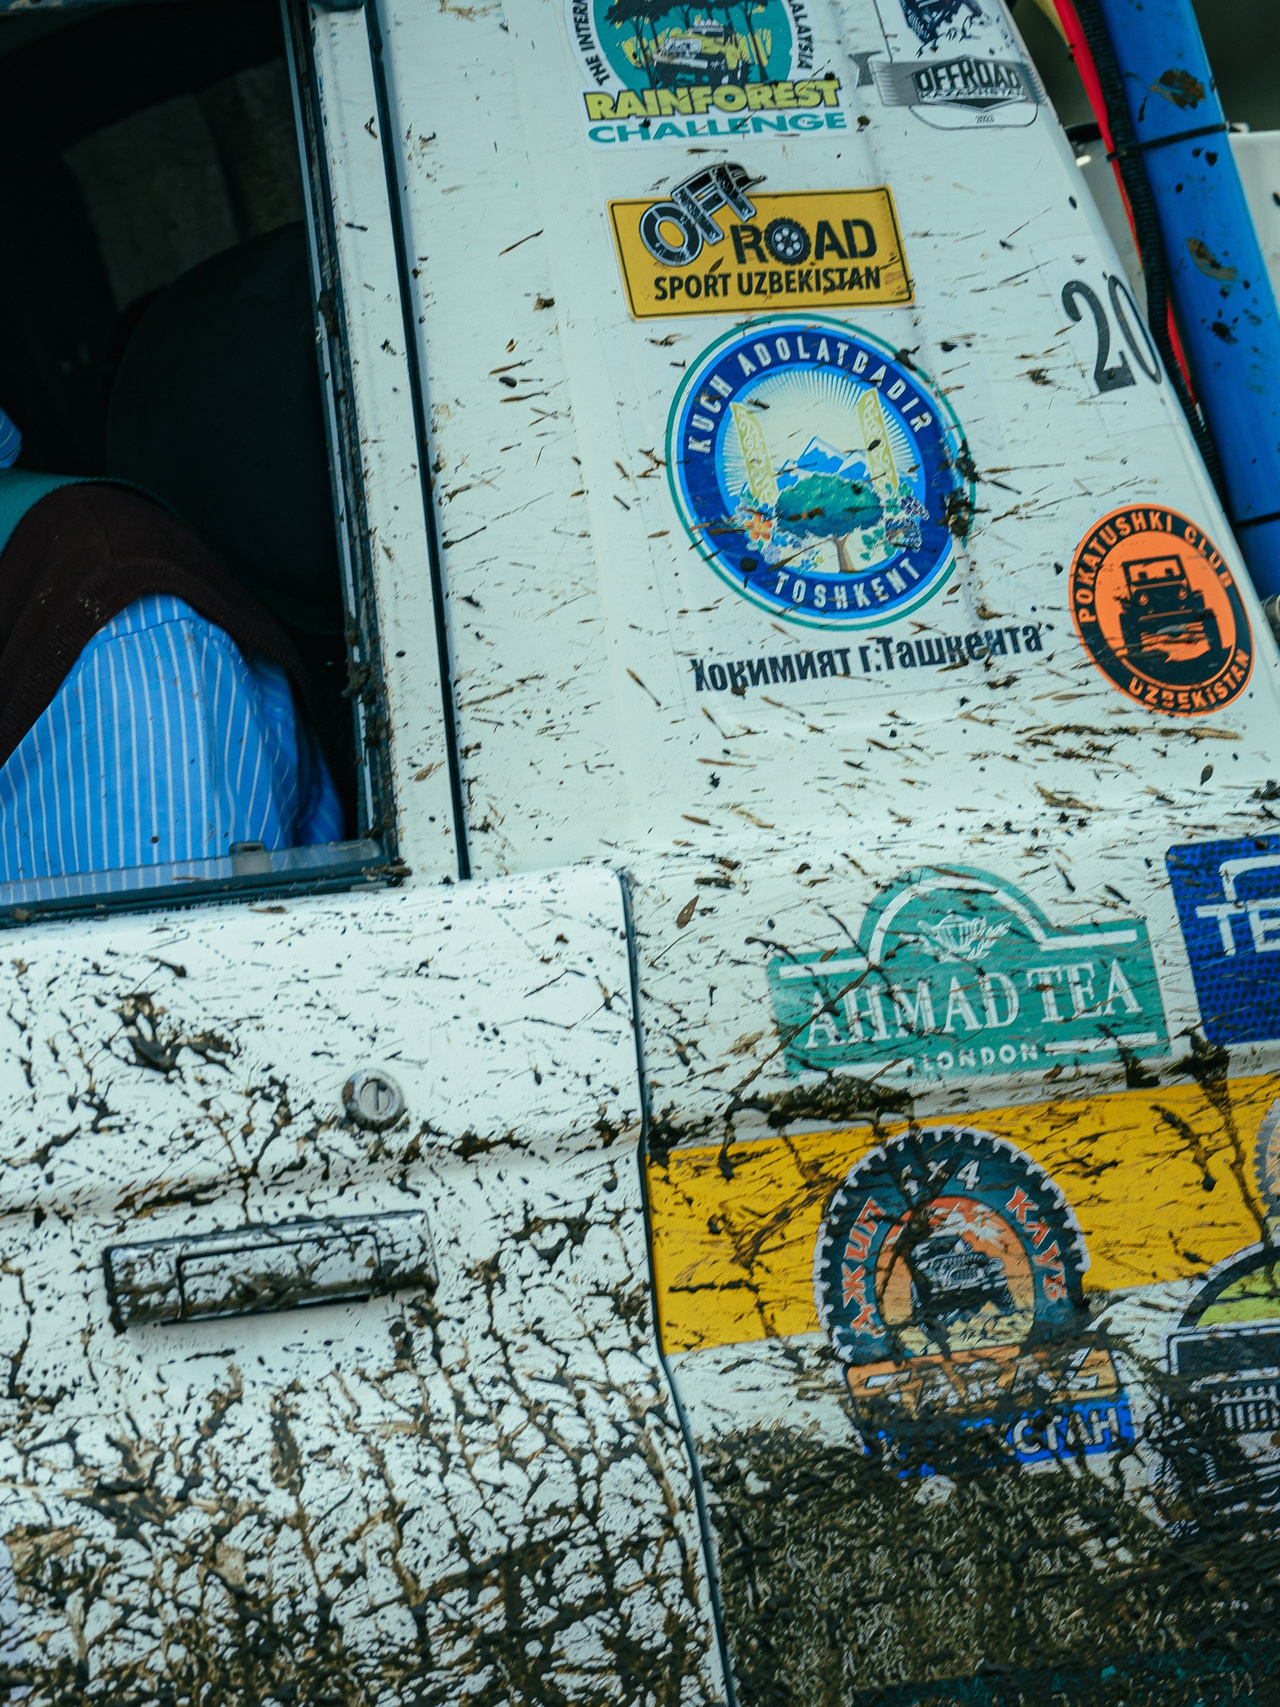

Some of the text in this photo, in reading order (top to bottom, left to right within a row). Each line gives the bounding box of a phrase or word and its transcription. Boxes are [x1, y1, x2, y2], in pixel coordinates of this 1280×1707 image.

[787, 0, 815, 70] ALAYSIA
[586, 54, 611, 86] THE
[916, 58, 1021, 91] OFFROAD
[583, 79, 841, 121] RAINFOREST
[588, 111, 848, 143] CHALLENGE
[730, 216, 878, 267] ROAD
[653, 265, 880, 301] SPORT UZBEKISTAN
[1061, 275, 1162, 394] 20
[688, 335, 933, 454] KUCH ADOLATDADIR
[774, 555, 921, 610] TOSHKENT
[1075, 510, 1172, 624] POKATUSHKI
[694, 646, 851, 693] Хокимият
[1128, 648, 1250, 710] UZBEKISTAN
[805, 957, 1144, 1049] AHMAD TEA
[922, 1042, 1039, 1072] LONDON
[1005, 1185, 1068, 1302] КЛУБ
